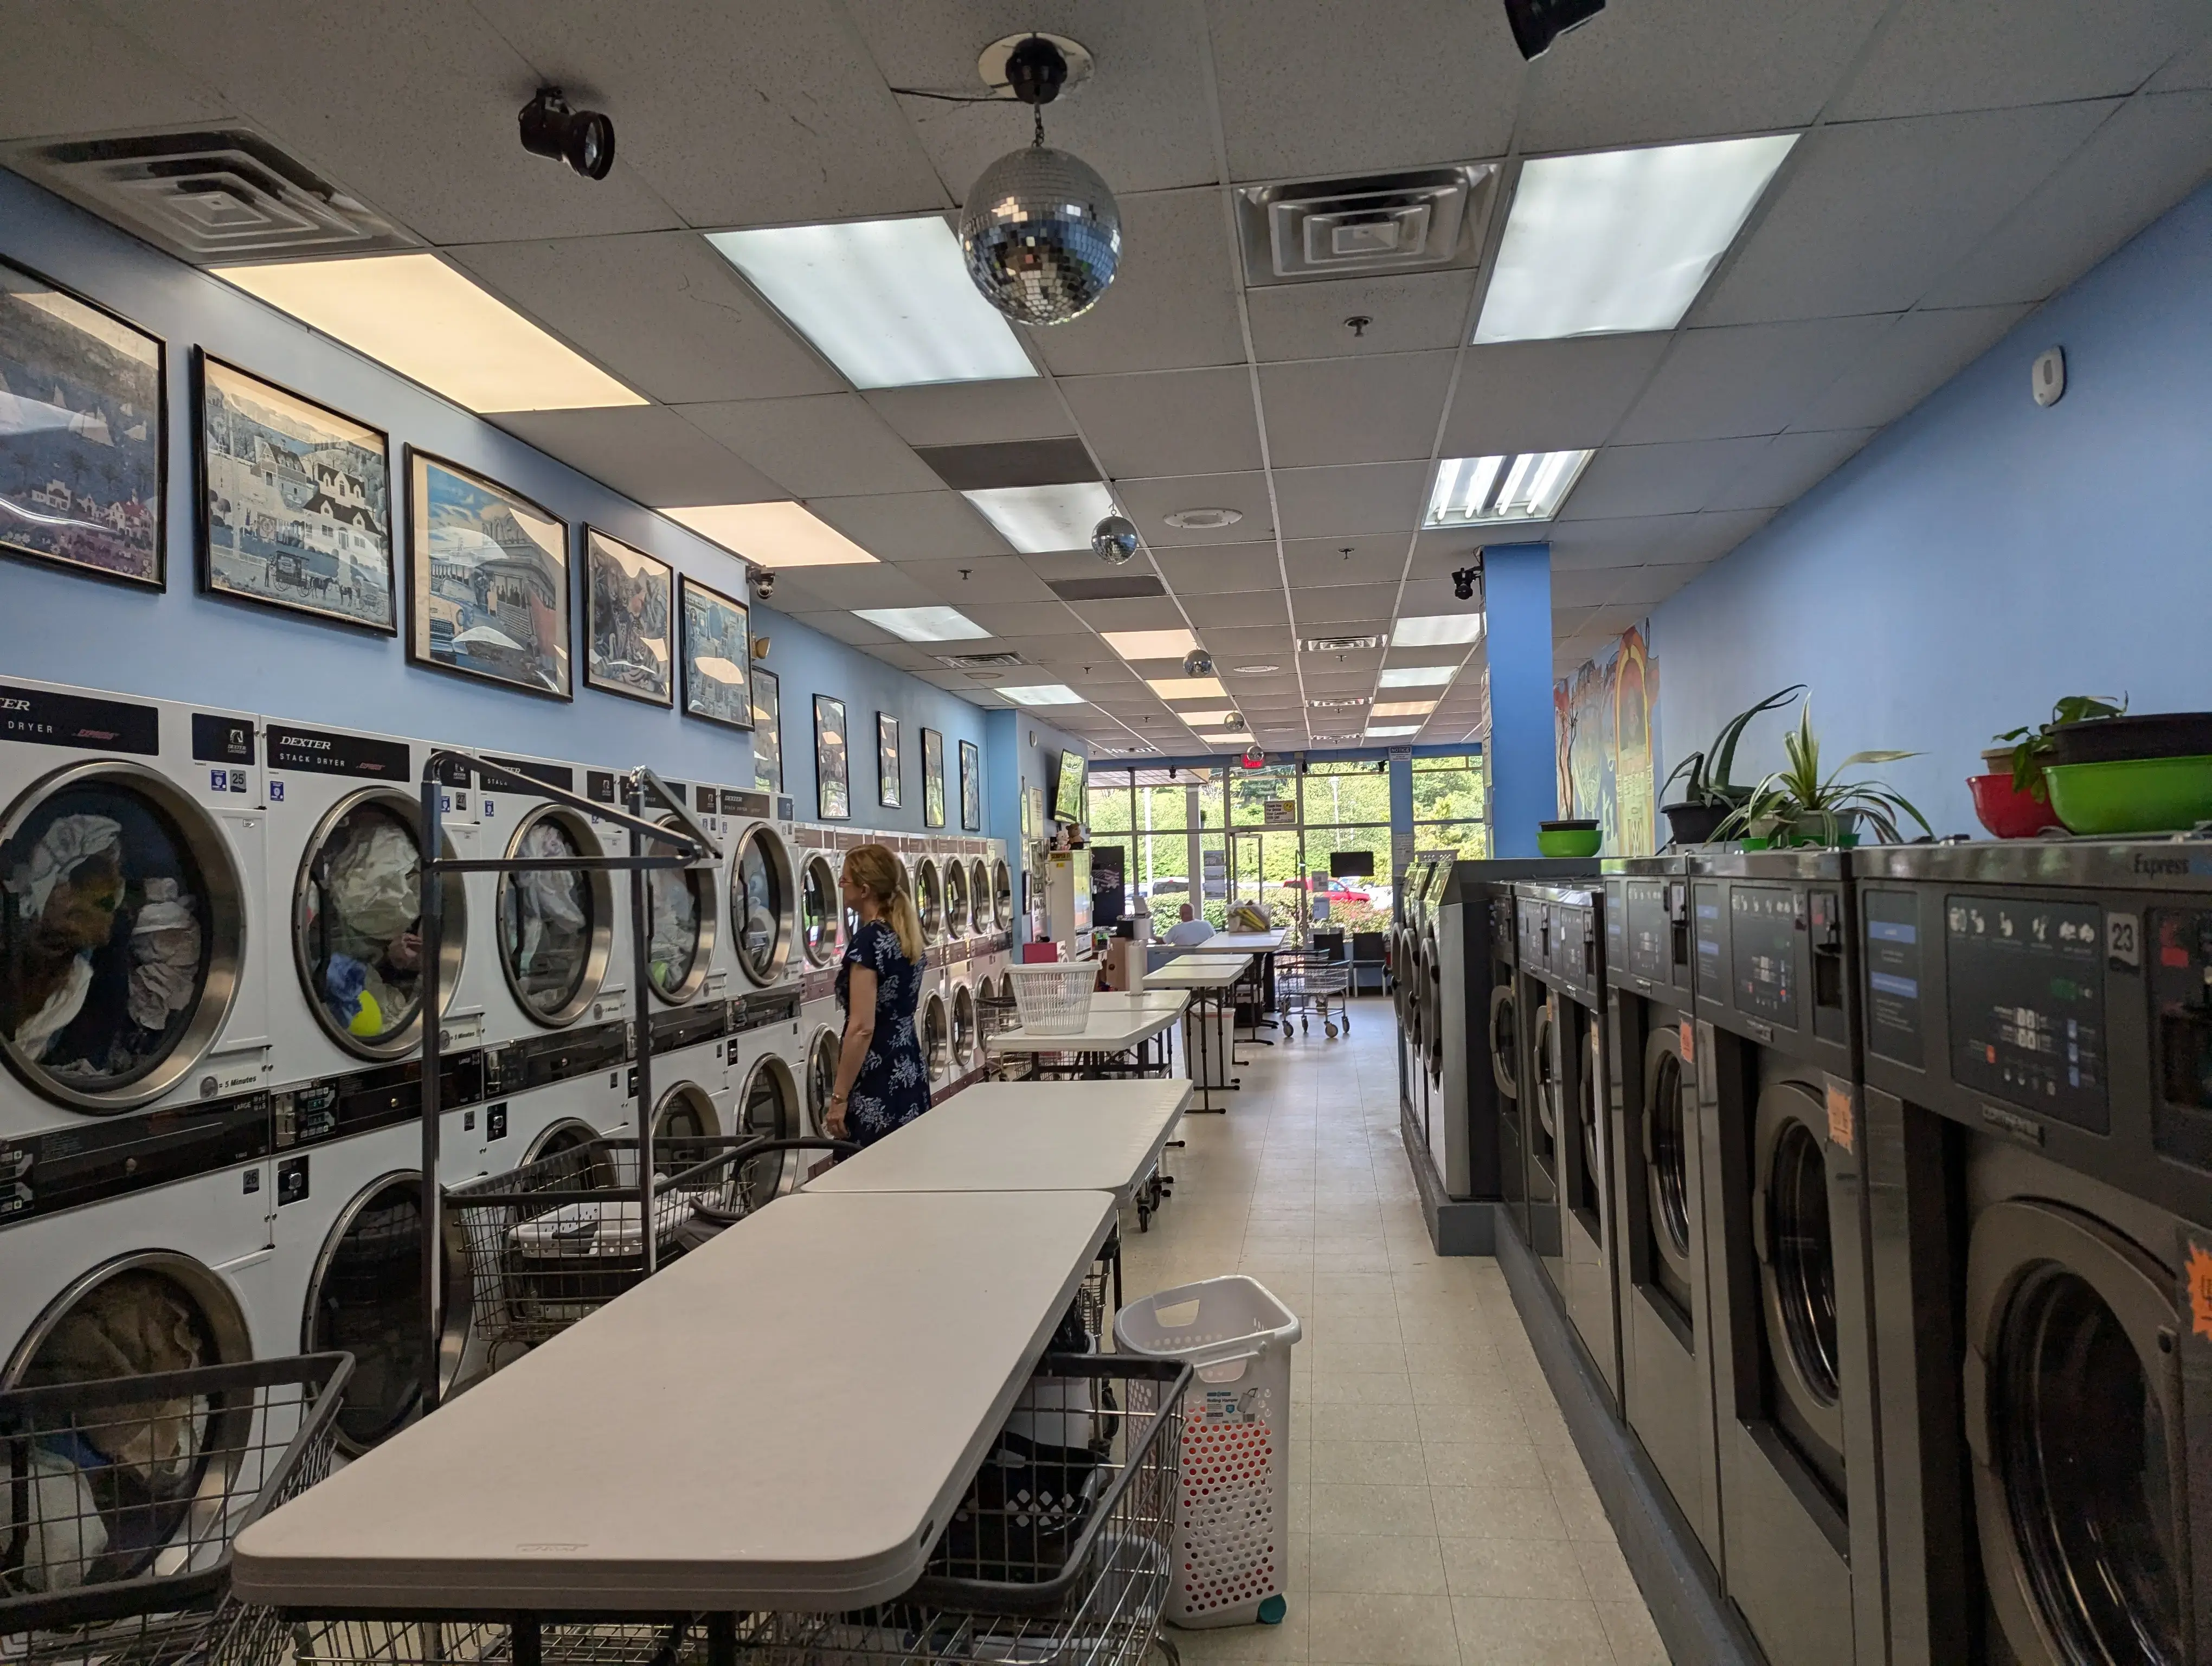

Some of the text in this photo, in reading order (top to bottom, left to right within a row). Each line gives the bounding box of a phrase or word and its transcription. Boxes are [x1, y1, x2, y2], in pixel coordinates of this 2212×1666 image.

[8, 721, 53, 733] DRYER
[280, 736, 331, 750] DEXTER
[280, 753, 345, 767] STACK DRYER
[232, 773, 244, 785] 25
[457, 794, 465, 803] 27
[2112, 923, 2133, 953] 23
[230, 1076, 257, 1086] Minutes
[234, 1101, 251, 1111] LARGE
[246, 1172, 257, 1185] 26
